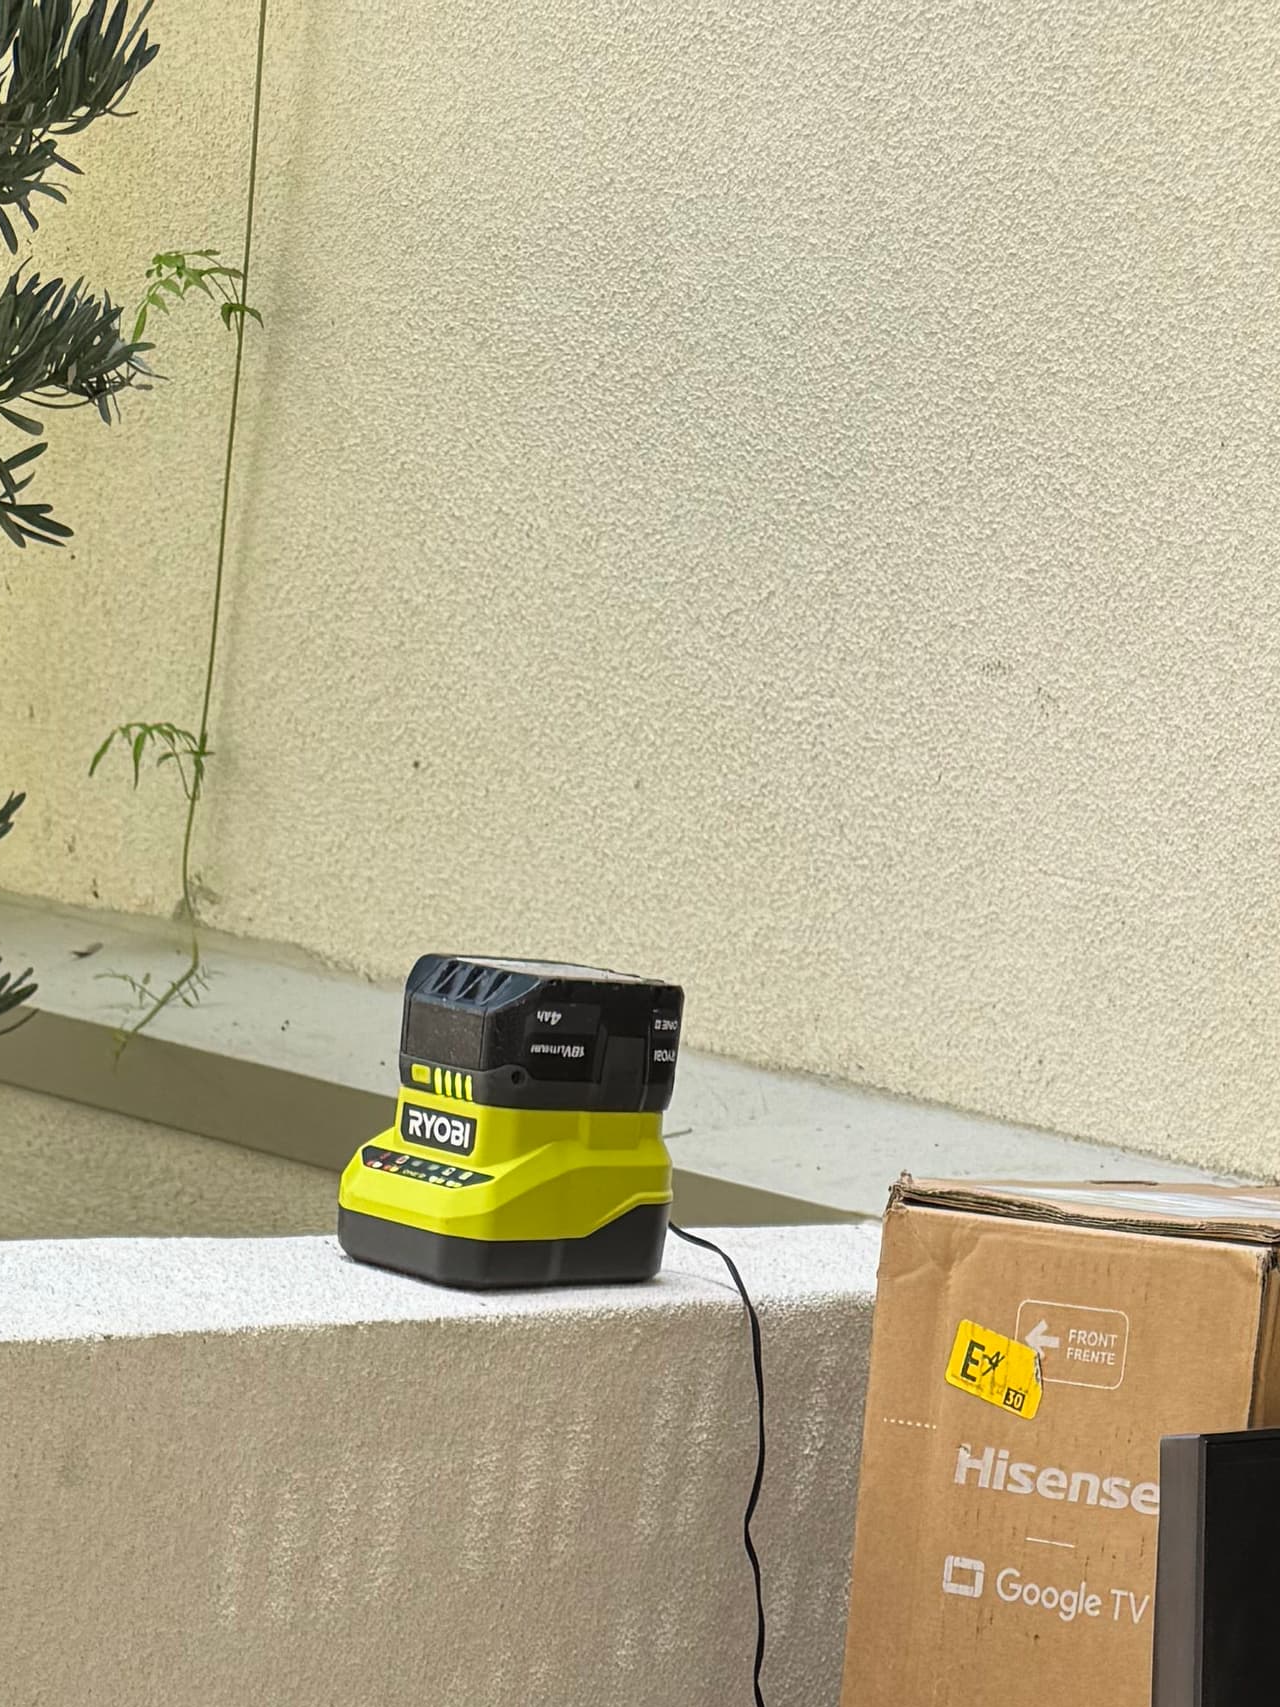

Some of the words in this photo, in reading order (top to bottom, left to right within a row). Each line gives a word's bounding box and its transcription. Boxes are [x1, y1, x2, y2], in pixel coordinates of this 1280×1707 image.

[408, 1108, 471, 1149] RYOBI
[1067, 1347, 1116, 1366] FRENTE
[1069, 1329, 1118, 1348] FRONT
[954, 1443, 1160, 1516] Hisense
[996, 1567, 1103, 1621] Google
[1110, 1588, 1150, 1624] TV
